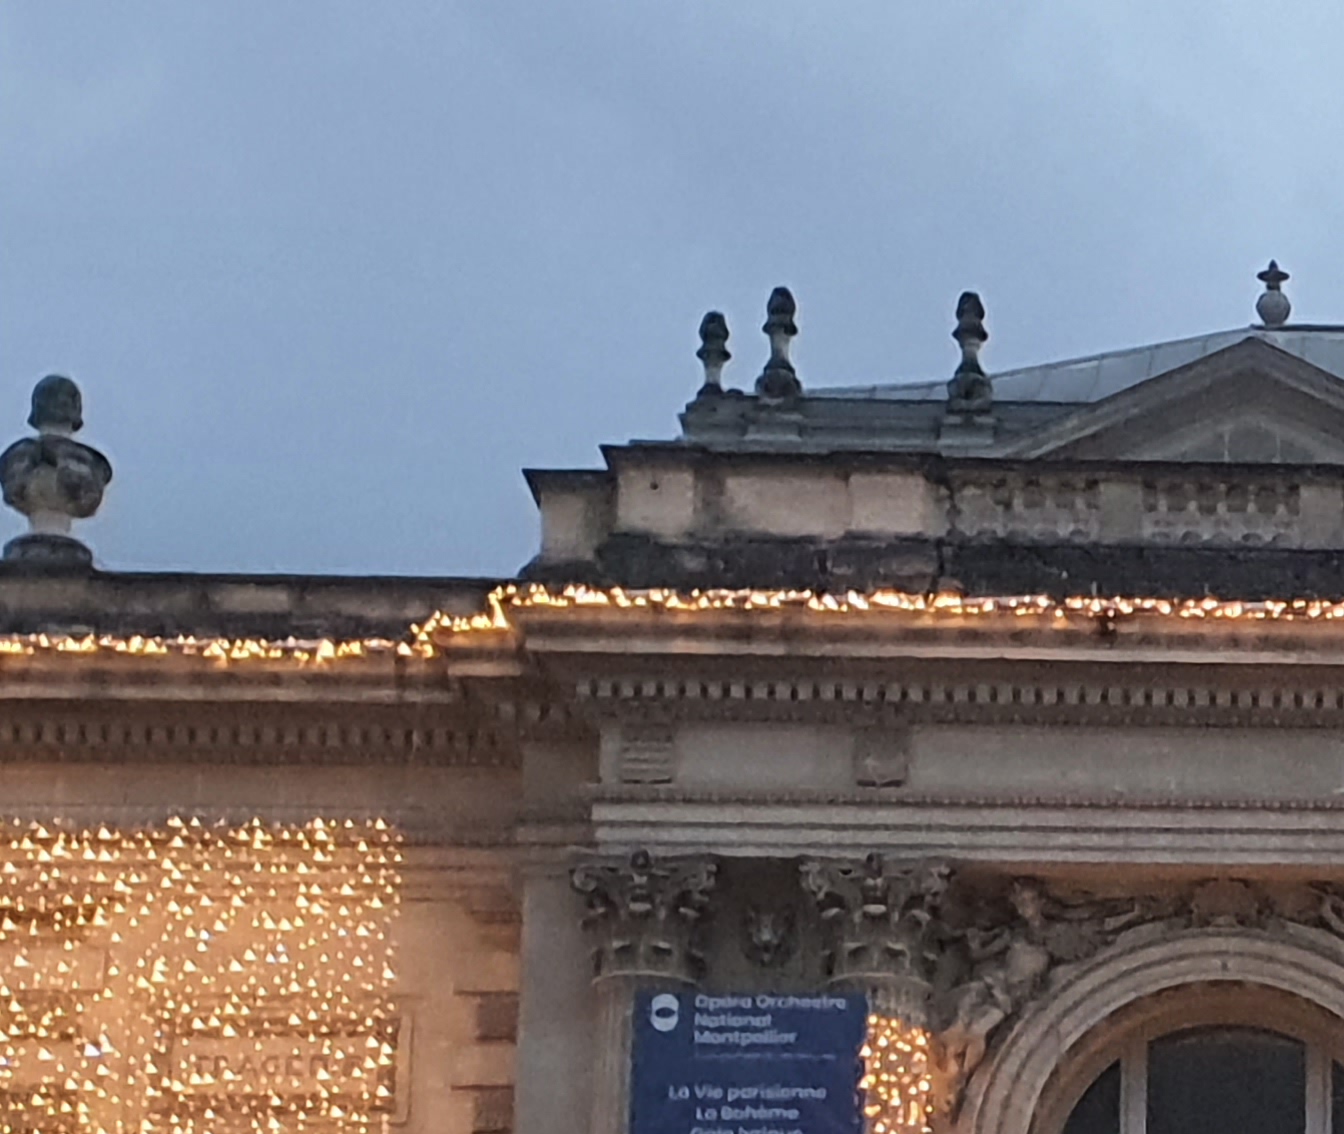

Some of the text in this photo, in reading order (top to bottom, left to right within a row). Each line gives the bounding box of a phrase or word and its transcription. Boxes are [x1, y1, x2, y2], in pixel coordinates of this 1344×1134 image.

[694, 1012, 772, 1027] National
[694, 1030, 798, 1046] Montpellier
[694, 1084, 723, 1099] Vie
[727, 1085, 827, 1102] parisienne
